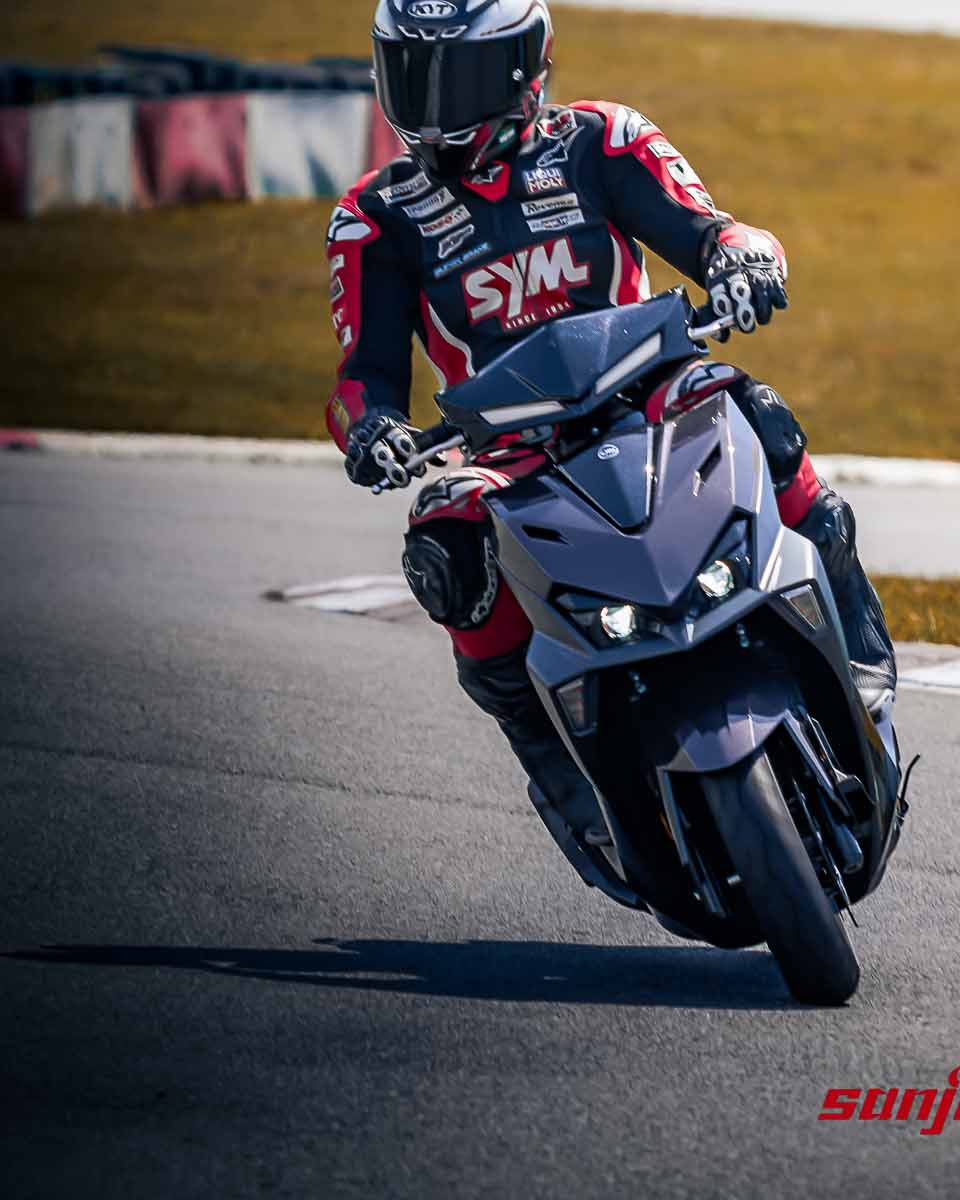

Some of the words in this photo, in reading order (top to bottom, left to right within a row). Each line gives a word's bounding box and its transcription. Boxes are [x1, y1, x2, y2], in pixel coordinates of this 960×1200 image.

[410, 2, 450, 16] KYT
[527, 176, 565, 193] MOLY
[465, 238, 588, 320] SYM
